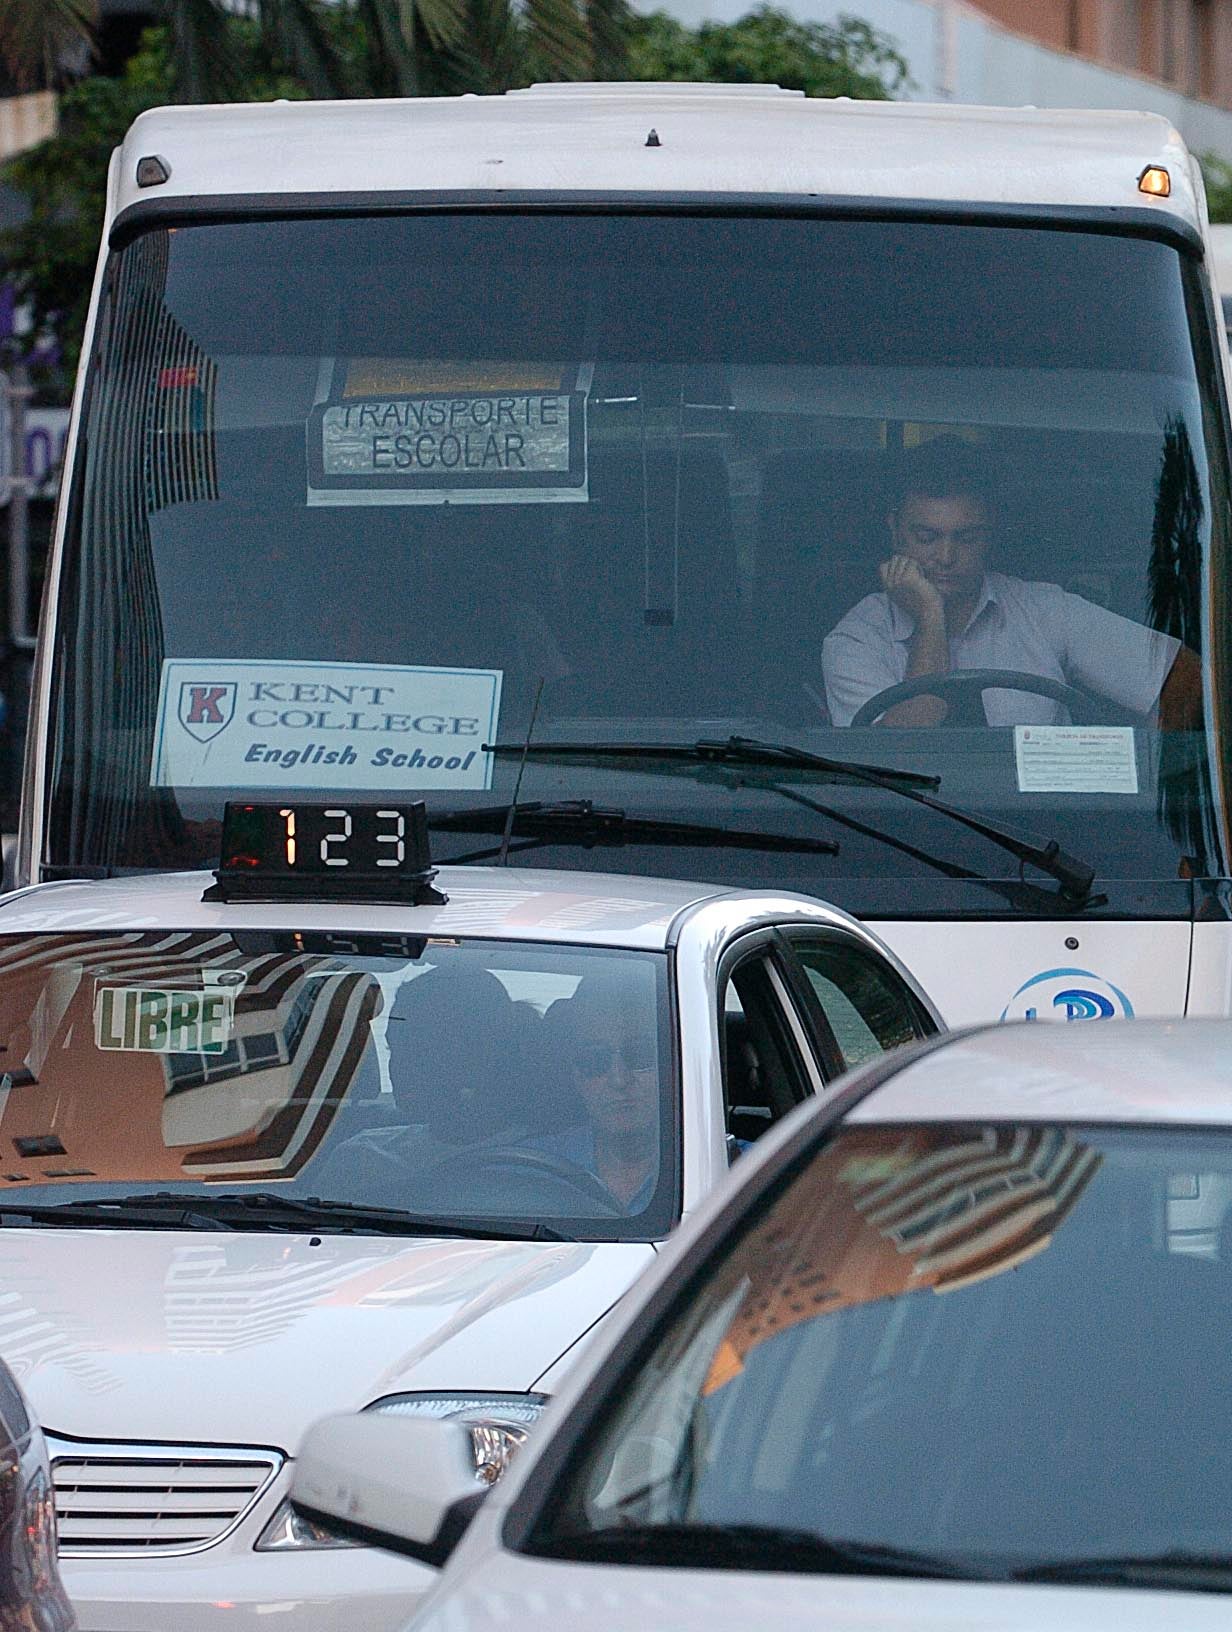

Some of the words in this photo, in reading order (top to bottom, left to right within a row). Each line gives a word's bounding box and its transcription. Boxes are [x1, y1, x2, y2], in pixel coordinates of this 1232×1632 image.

[341, 397, 559, 428] TRANSPORTE
[372, 433, 526, 468] ESCOLAR
[187, 687, 228, 723] K
[248, 682, 395, 705] KENT
[246, 709, 480, 736] COLLEGE
[244, 743, 357, 769] English
[370, 748, 477, 771] School
[100, 989, 224, 1053] LIBRE
